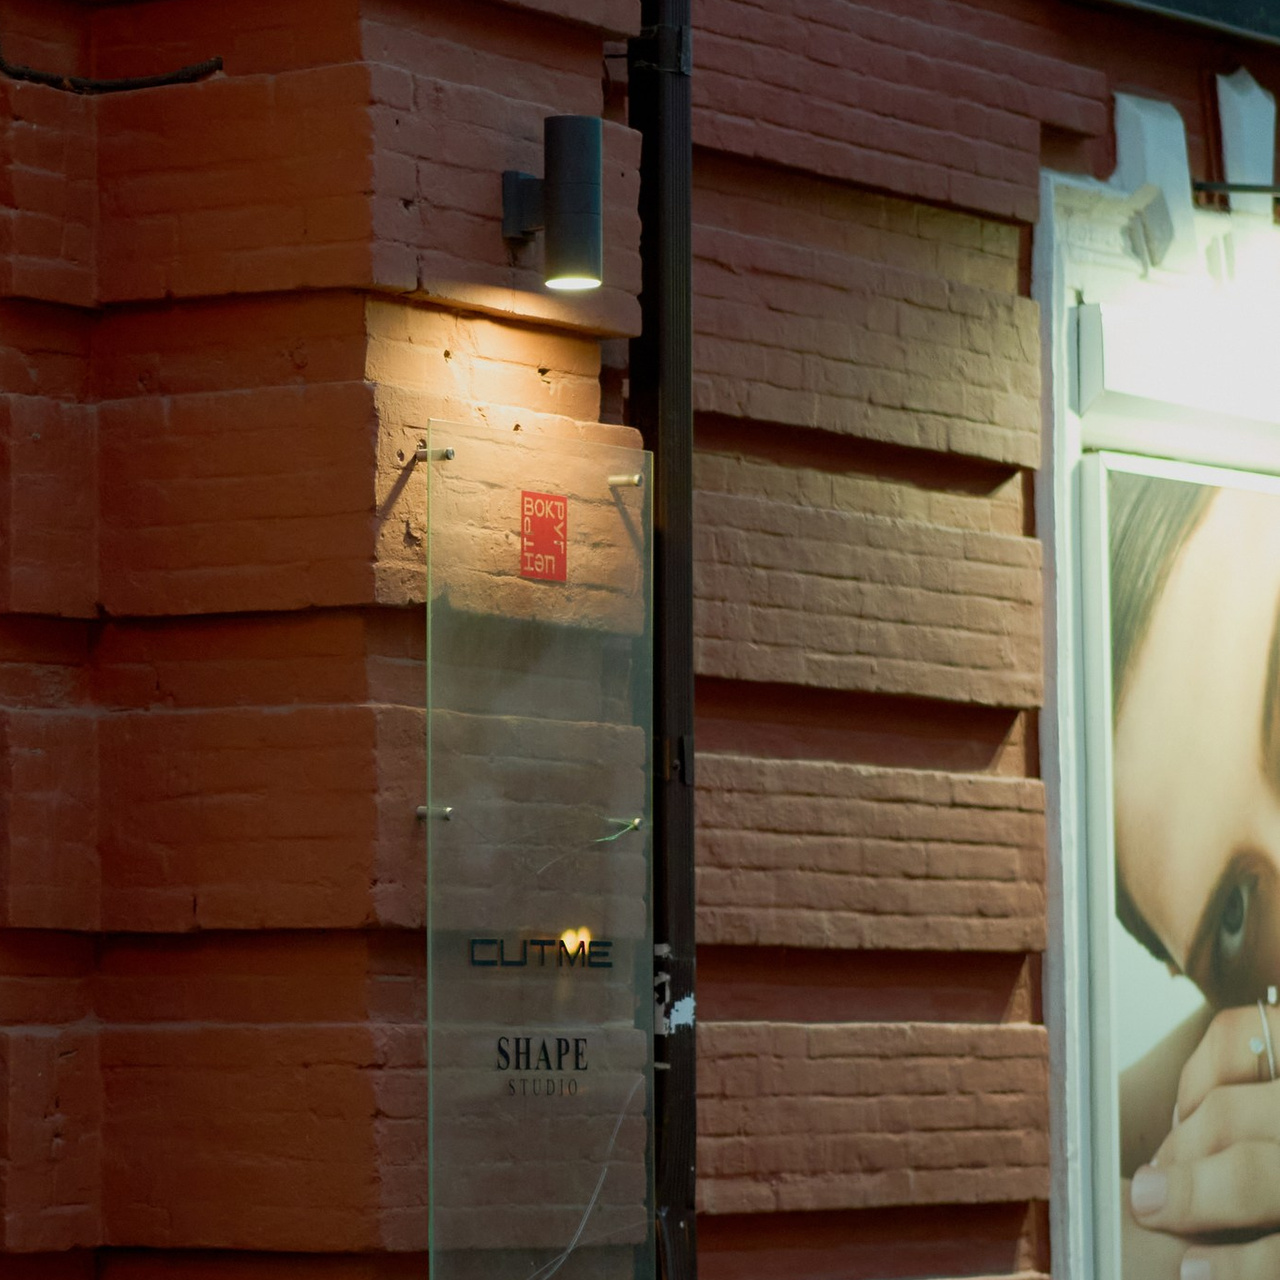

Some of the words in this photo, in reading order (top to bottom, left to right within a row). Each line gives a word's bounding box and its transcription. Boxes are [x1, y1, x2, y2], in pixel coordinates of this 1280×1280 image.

[470, 938, 613, 968] CUTME
[496, 1036, 589, 1071] SHAPE
[508, 1078, 578, 1096] STUDIO
